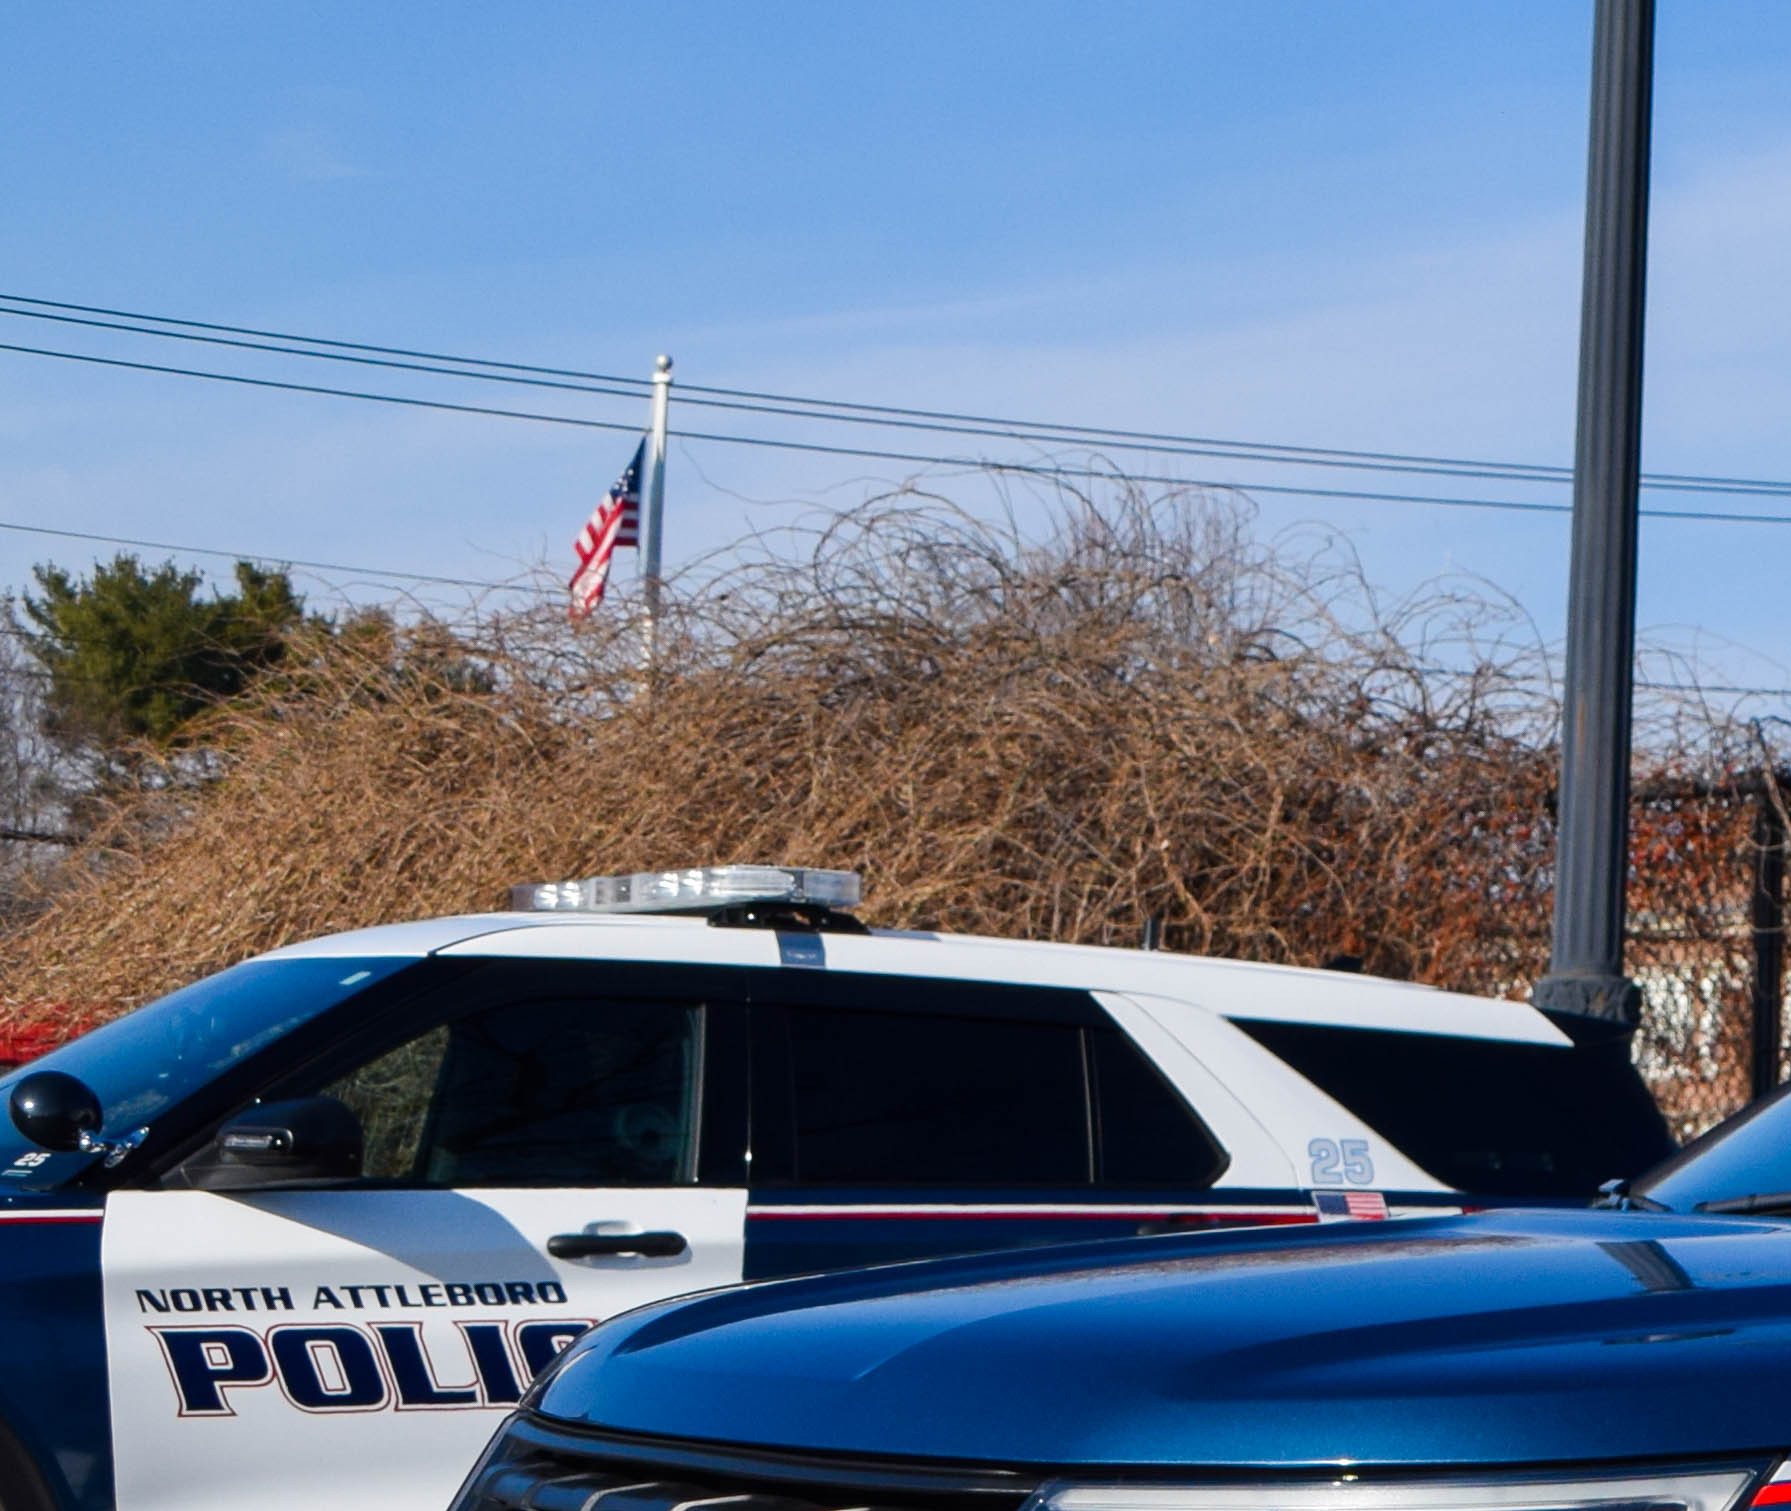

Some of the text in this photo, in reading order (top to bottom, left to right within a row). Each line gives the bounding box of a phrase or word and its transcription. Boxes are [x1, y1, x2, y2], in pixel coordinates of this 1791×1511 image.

[14, 1151, 52, 1168] 25
[1307, 1137, 1375, 1185] 25
[135, 1280, 568, 1313] NORTH ATTLEBORO
[144, 1317, 600, 1418] POLIC
